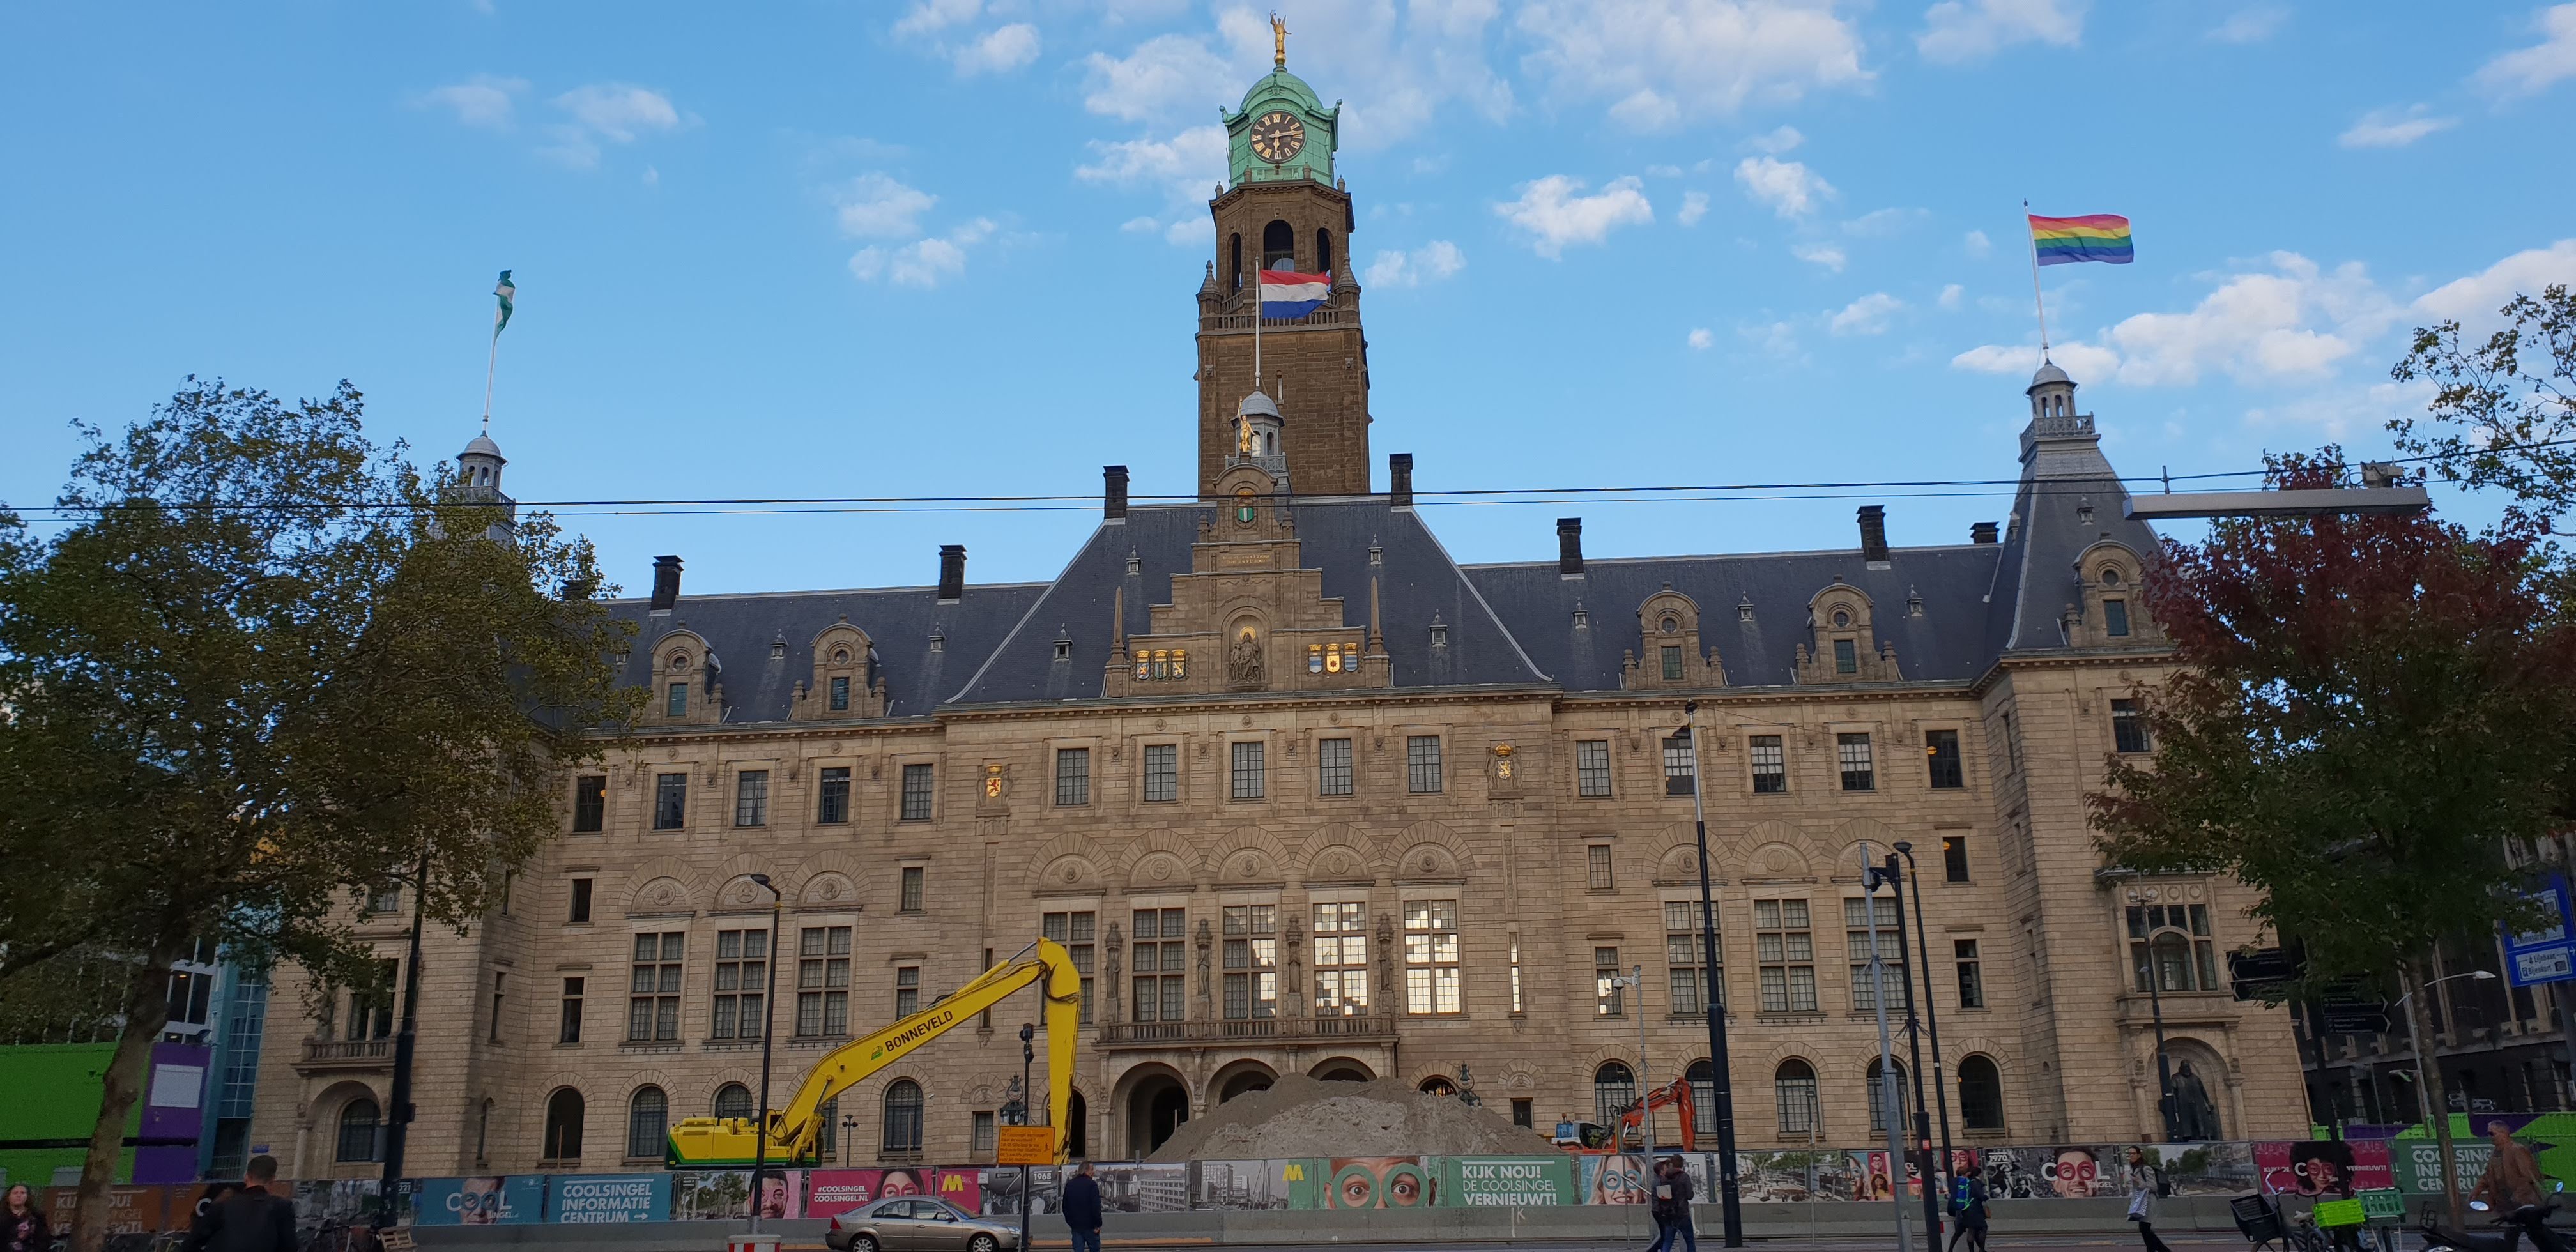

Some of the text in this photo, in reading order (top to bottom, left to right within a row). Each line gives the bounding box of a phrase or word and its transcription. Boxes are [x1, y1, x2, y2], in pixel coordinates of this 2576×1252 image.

[885, 1011, 953, 1052] BONNEVELD
[1462, 1165, 1541, 1179] KIJK NOU!
[563, 1184, 652, 1198] COOLSINGEL
[1463, 1179, 1556, 1191] DE COOLSINGEL
[446, 1190, 512, 1212] COOL
[562, 1197, 650, 1210] INFORMATIE
[1463, 1193, 1558, 1205] VERNIEUWT!
[560, 1211, 629, 1223] CENTRUM
